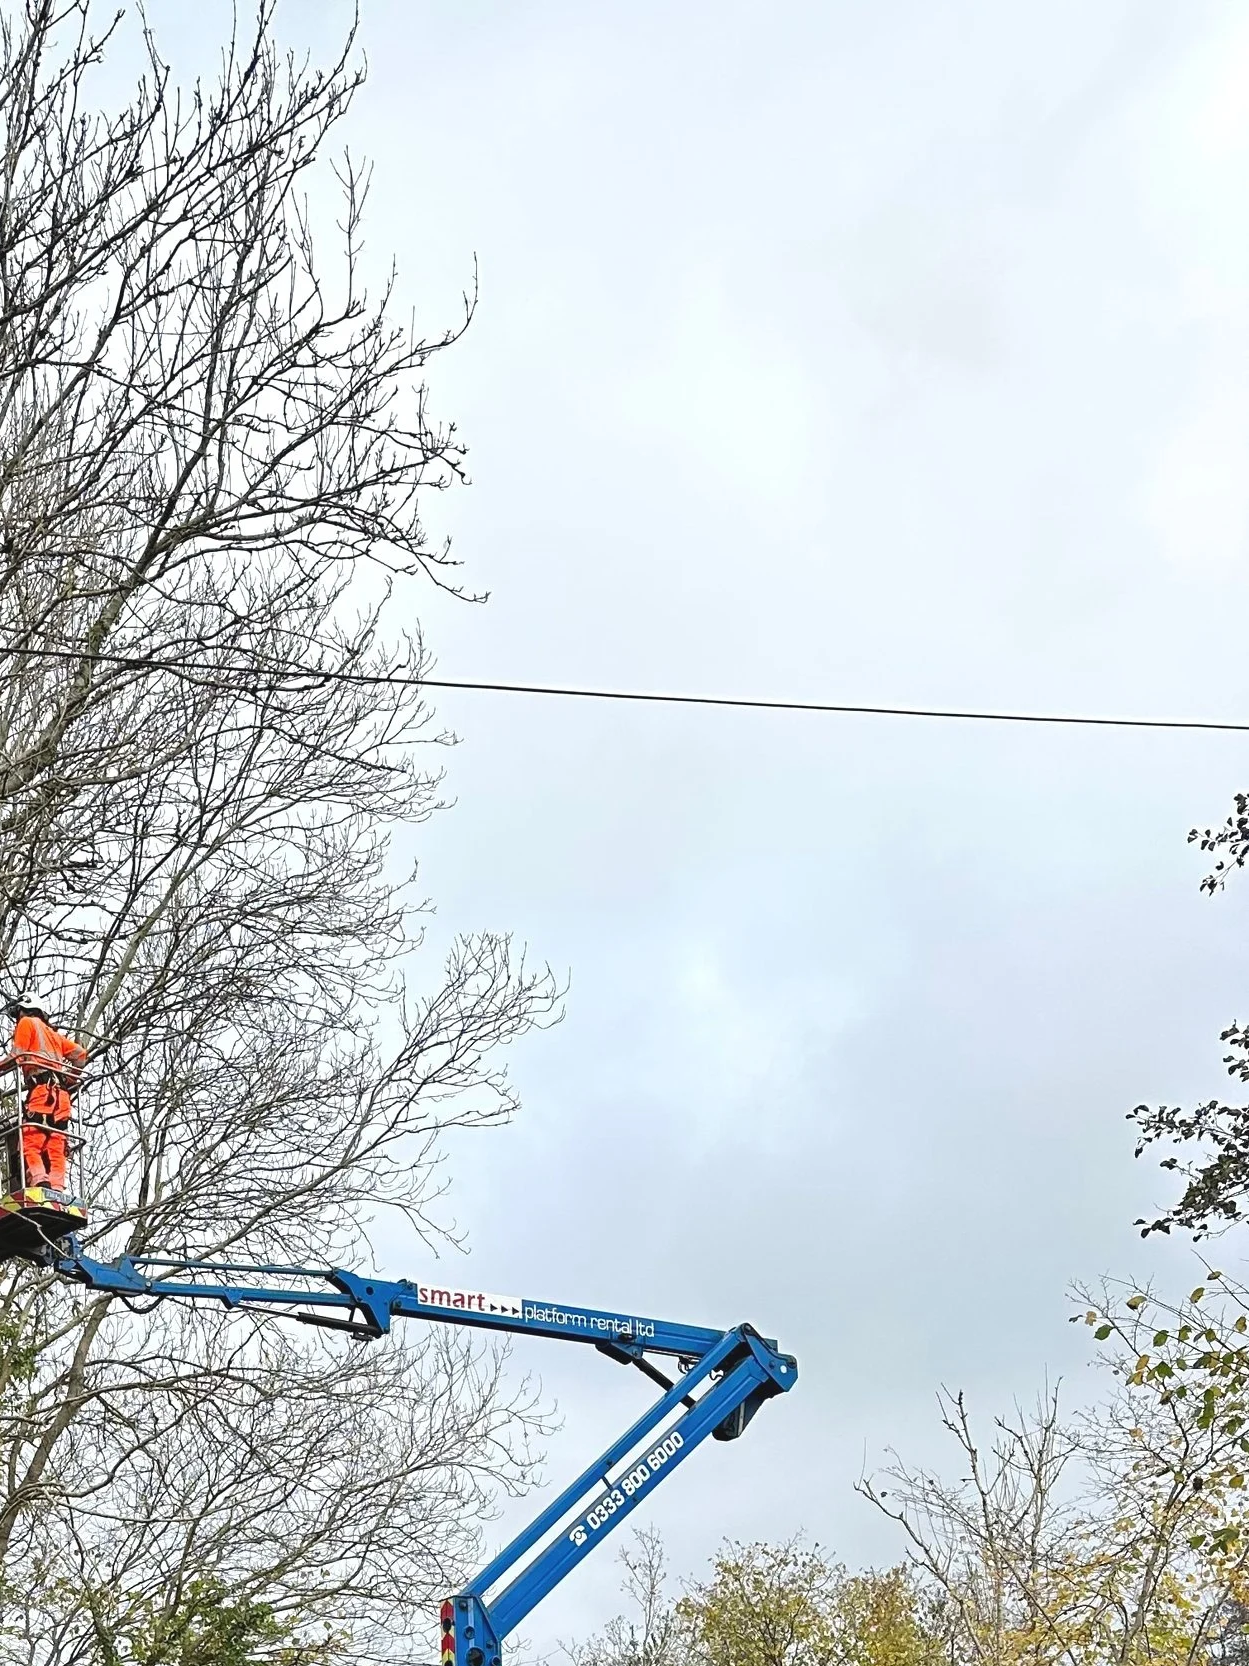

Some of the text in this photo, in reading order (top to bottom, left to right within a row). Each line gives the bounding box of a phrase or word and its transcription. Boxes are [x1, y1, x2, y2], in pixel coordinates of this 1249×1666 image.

[419, 1287, 654, 1337] smart platform rental ltd
[586, 1431, 684, 1530] 0333 800 6000
